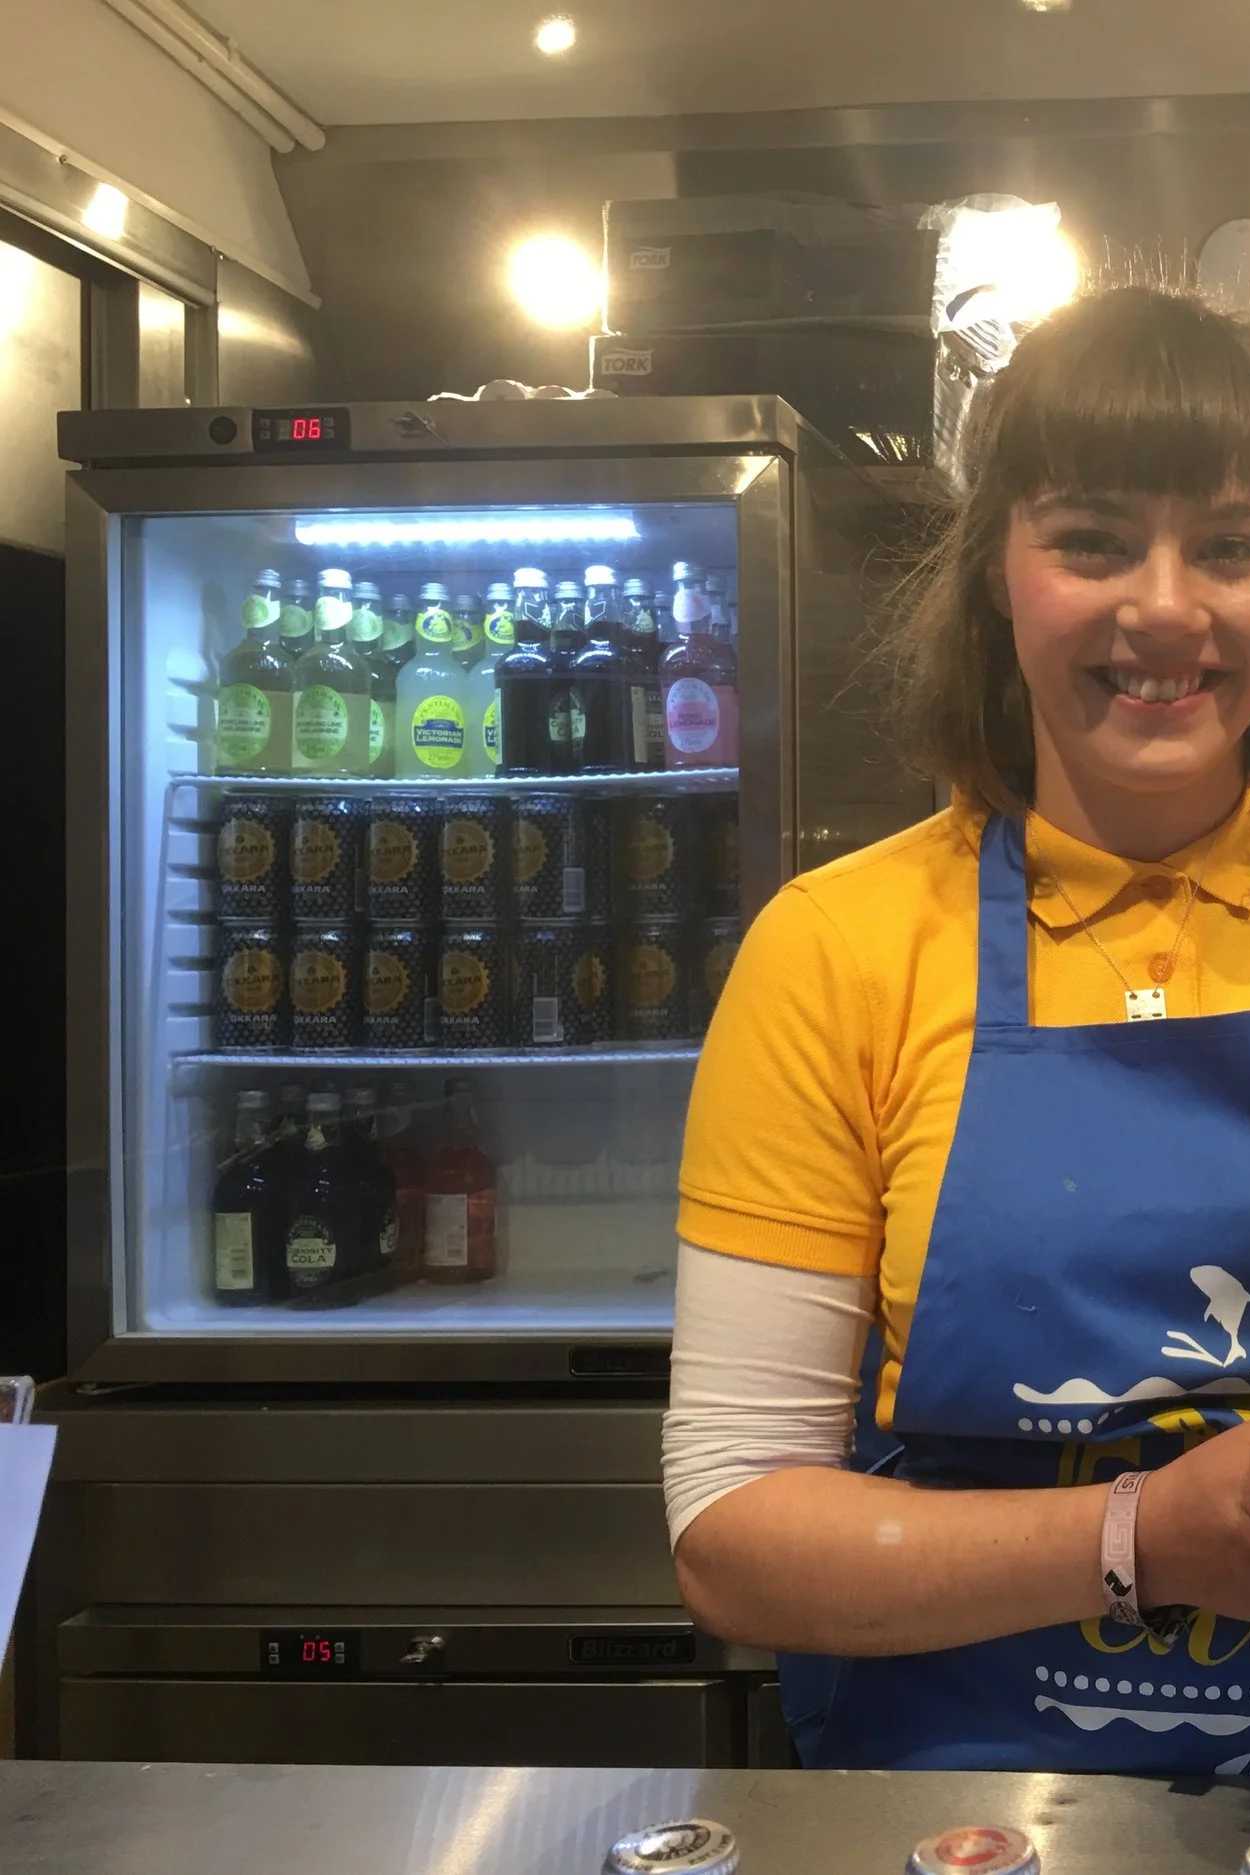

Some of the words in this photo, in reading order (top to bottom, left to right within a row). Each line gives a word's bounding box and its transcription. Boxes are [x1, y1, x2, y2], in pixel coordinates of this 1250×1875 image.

[632, 252, 668, 267] TORK
[603, 356, 649, 373] TORK
[293, 418, 321, 440] 06
[416, 729, 462, 738] VICTORIAN
[291, 1254, 326, 1264] COLA
[302, 1641, 331, 1662] 05
[582, 1638, 678, 1659] Blizzard
